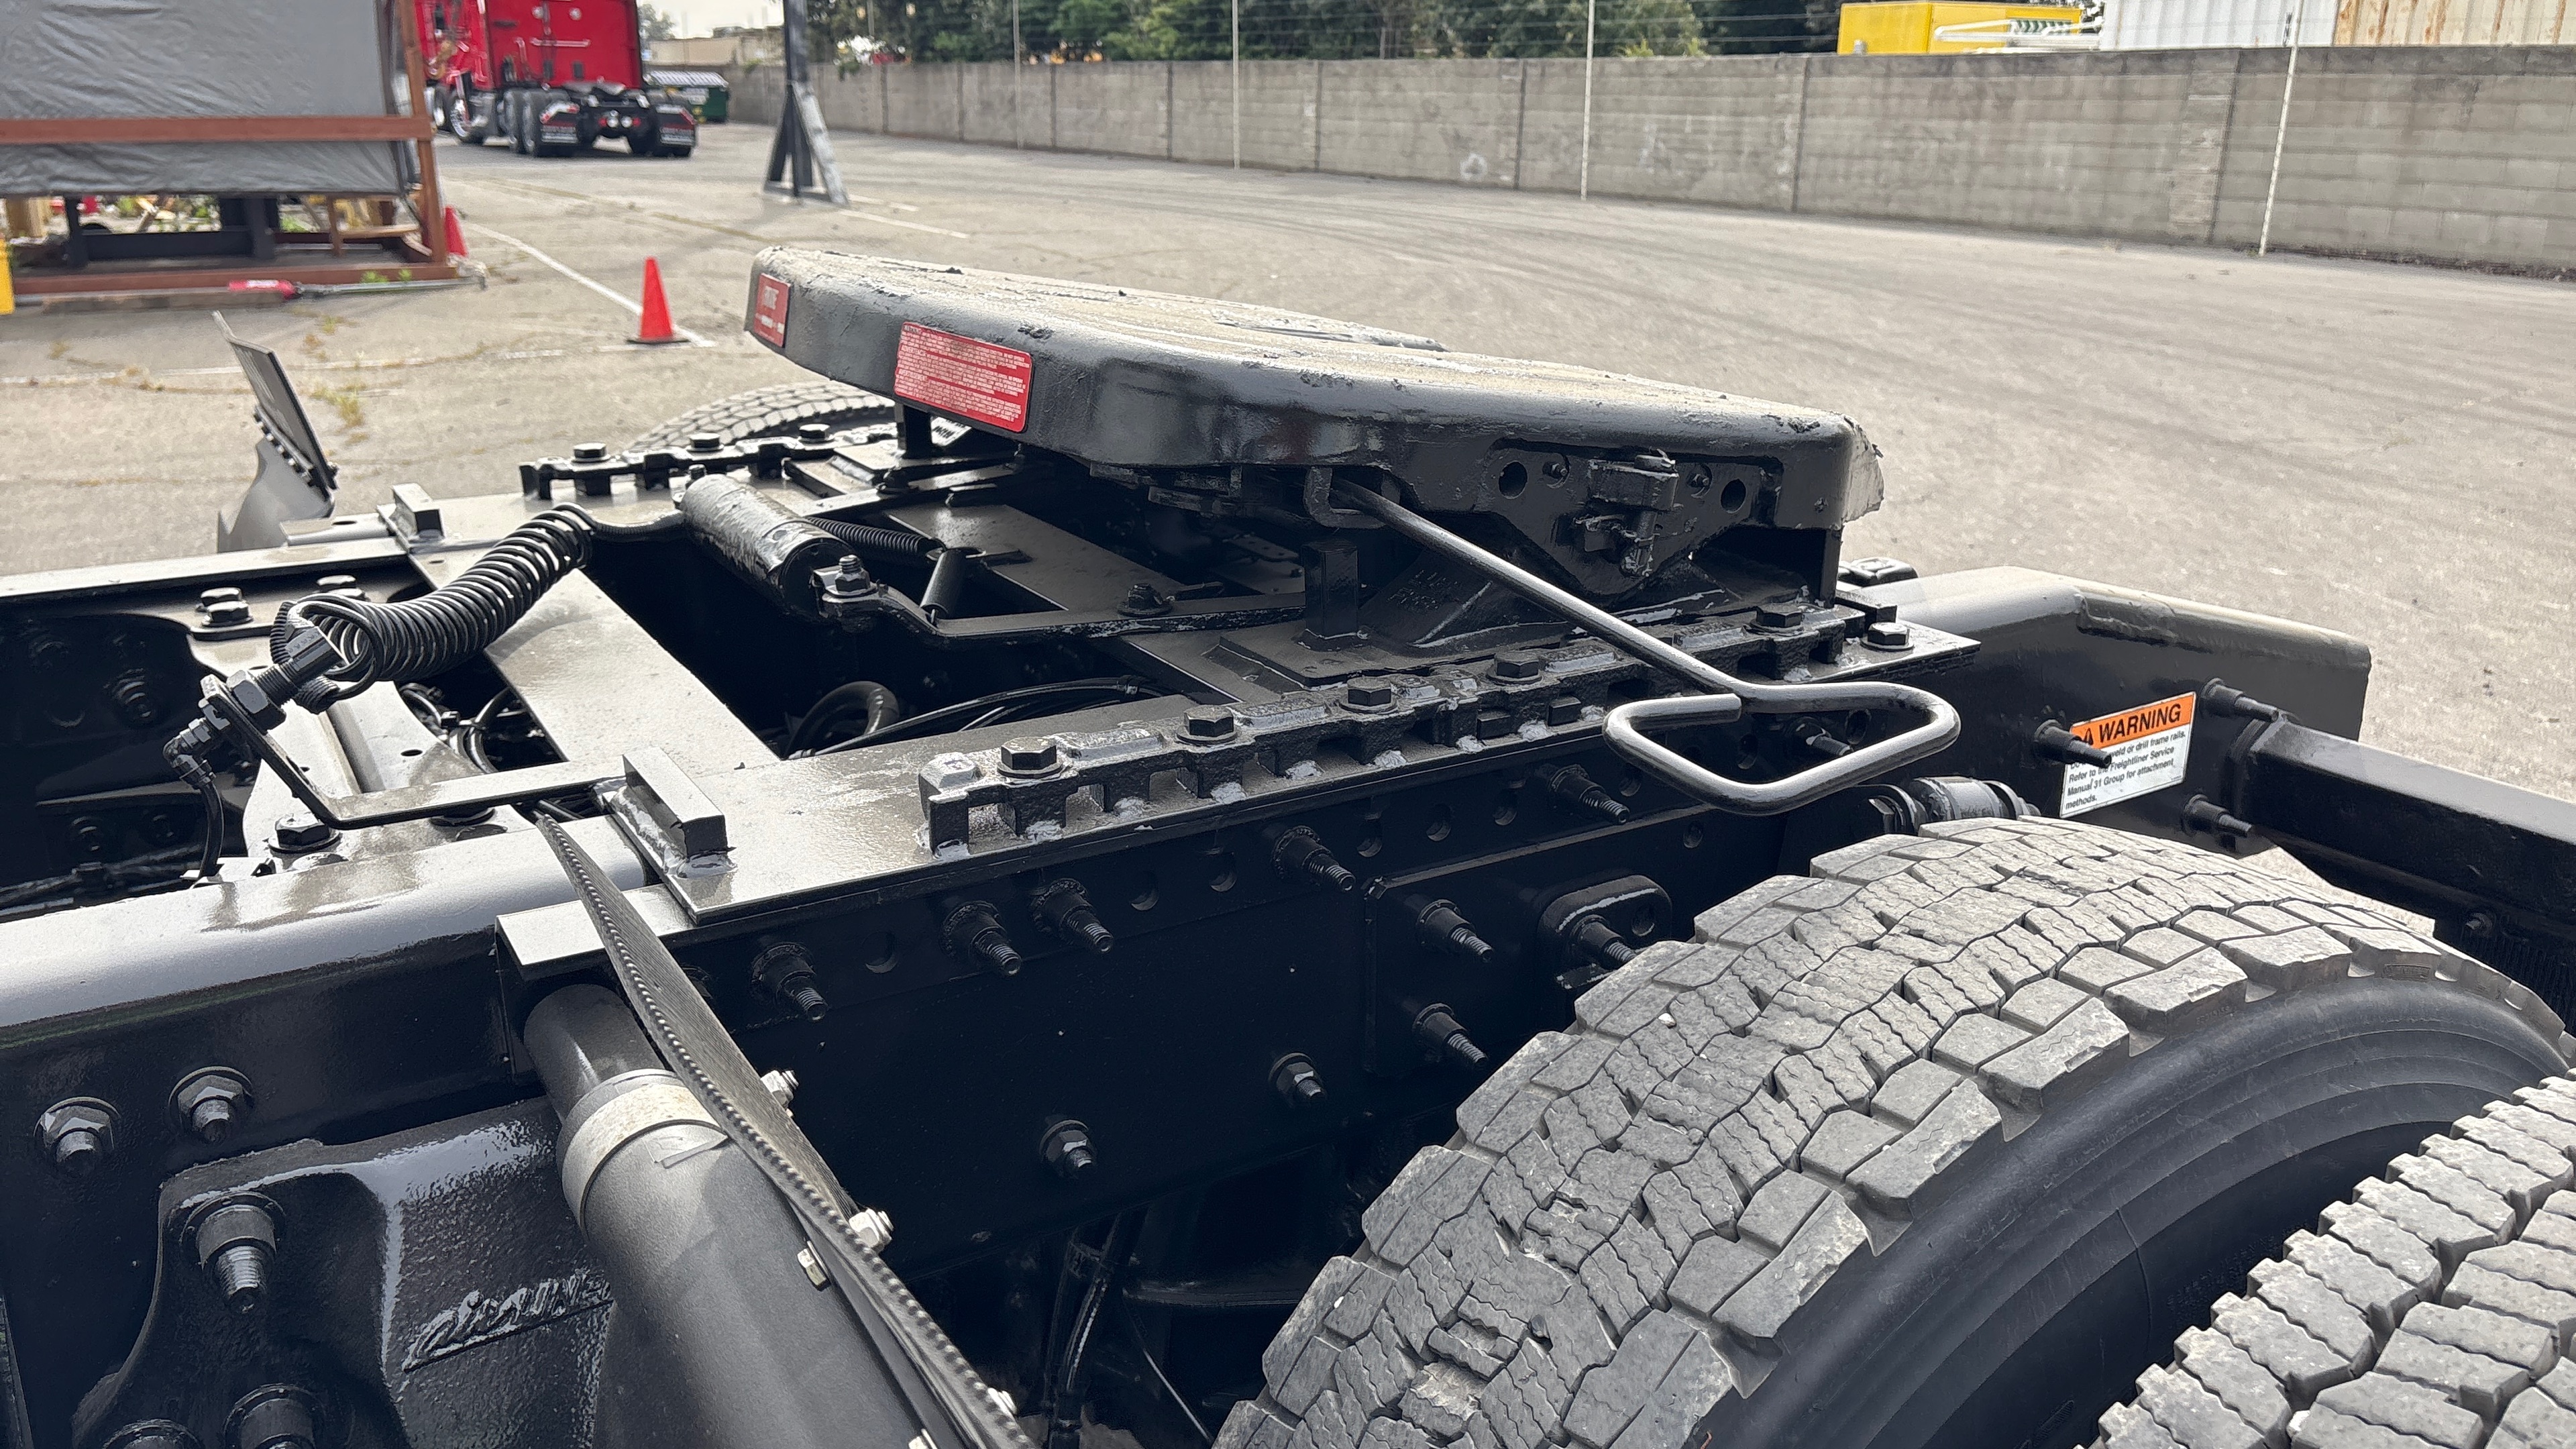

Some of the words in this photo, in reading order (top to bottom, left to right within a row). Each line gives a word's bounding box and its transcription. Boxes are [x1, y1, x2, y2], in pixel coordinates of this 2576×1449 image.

[2099, 703, 2182, 743] WARNING
[2127, 744, 2135, 753] or
[2135, 739, 2149, 751] drill
[2150, 735, 2169, 747] frame
[2068, 778, 2094, 796] Manual
[2094, 778, 2102, 790] 31
[2104, 773, 2125, 786] Group
[2127, 769, 2137, 779] for
[2137, 757, 2174, 776] attachment
[2069, 771, 2088, 784] Refer
[2089, 769, 2096, 777] to
[2110, 753, 2149, 771] Freightliner
[2150, 746, 2175, 759] Service
[2065, 794, 2098, 810] methods.
